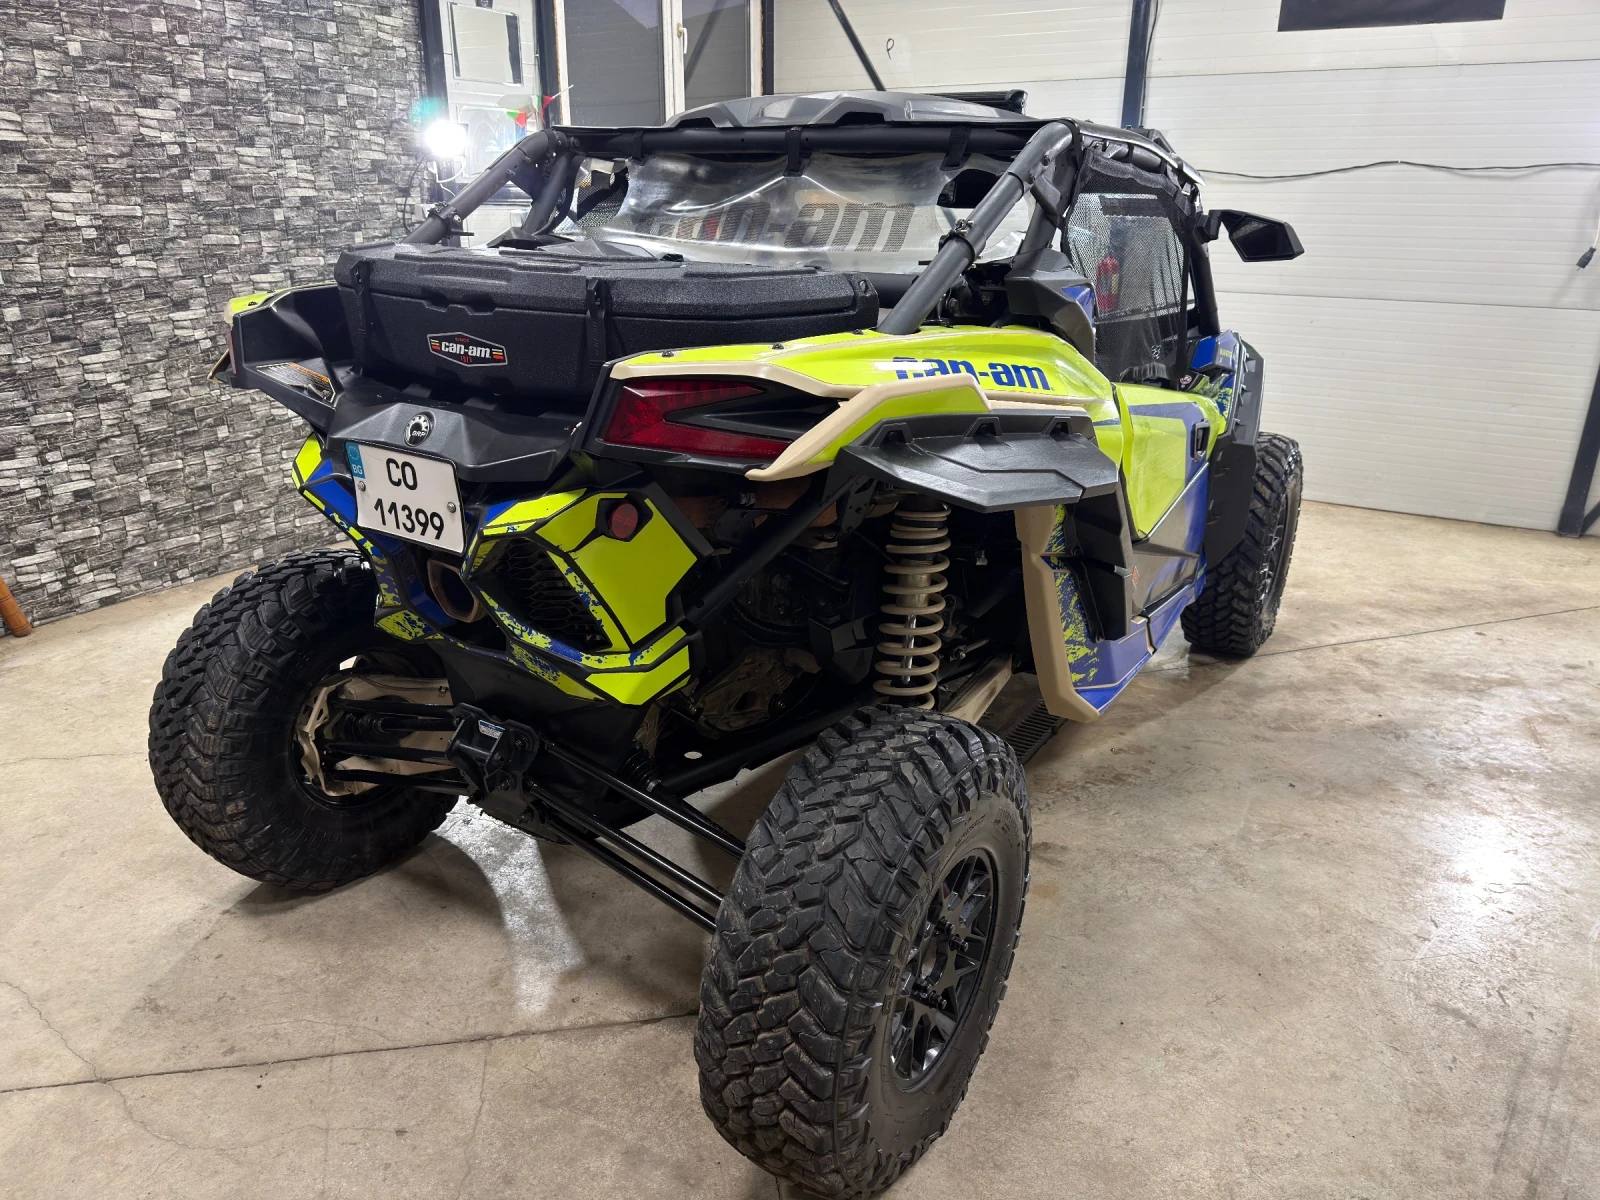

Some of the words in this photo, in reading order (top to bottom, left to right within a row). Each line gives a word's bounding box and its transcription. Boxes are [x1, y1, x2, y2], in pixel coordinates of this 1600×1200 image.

[441, 341, 491, 359] can-am
[351, 463, 363, 475] BG
[386, 457, 418, 491] CO
[373, 497, 445, 541] 11399
